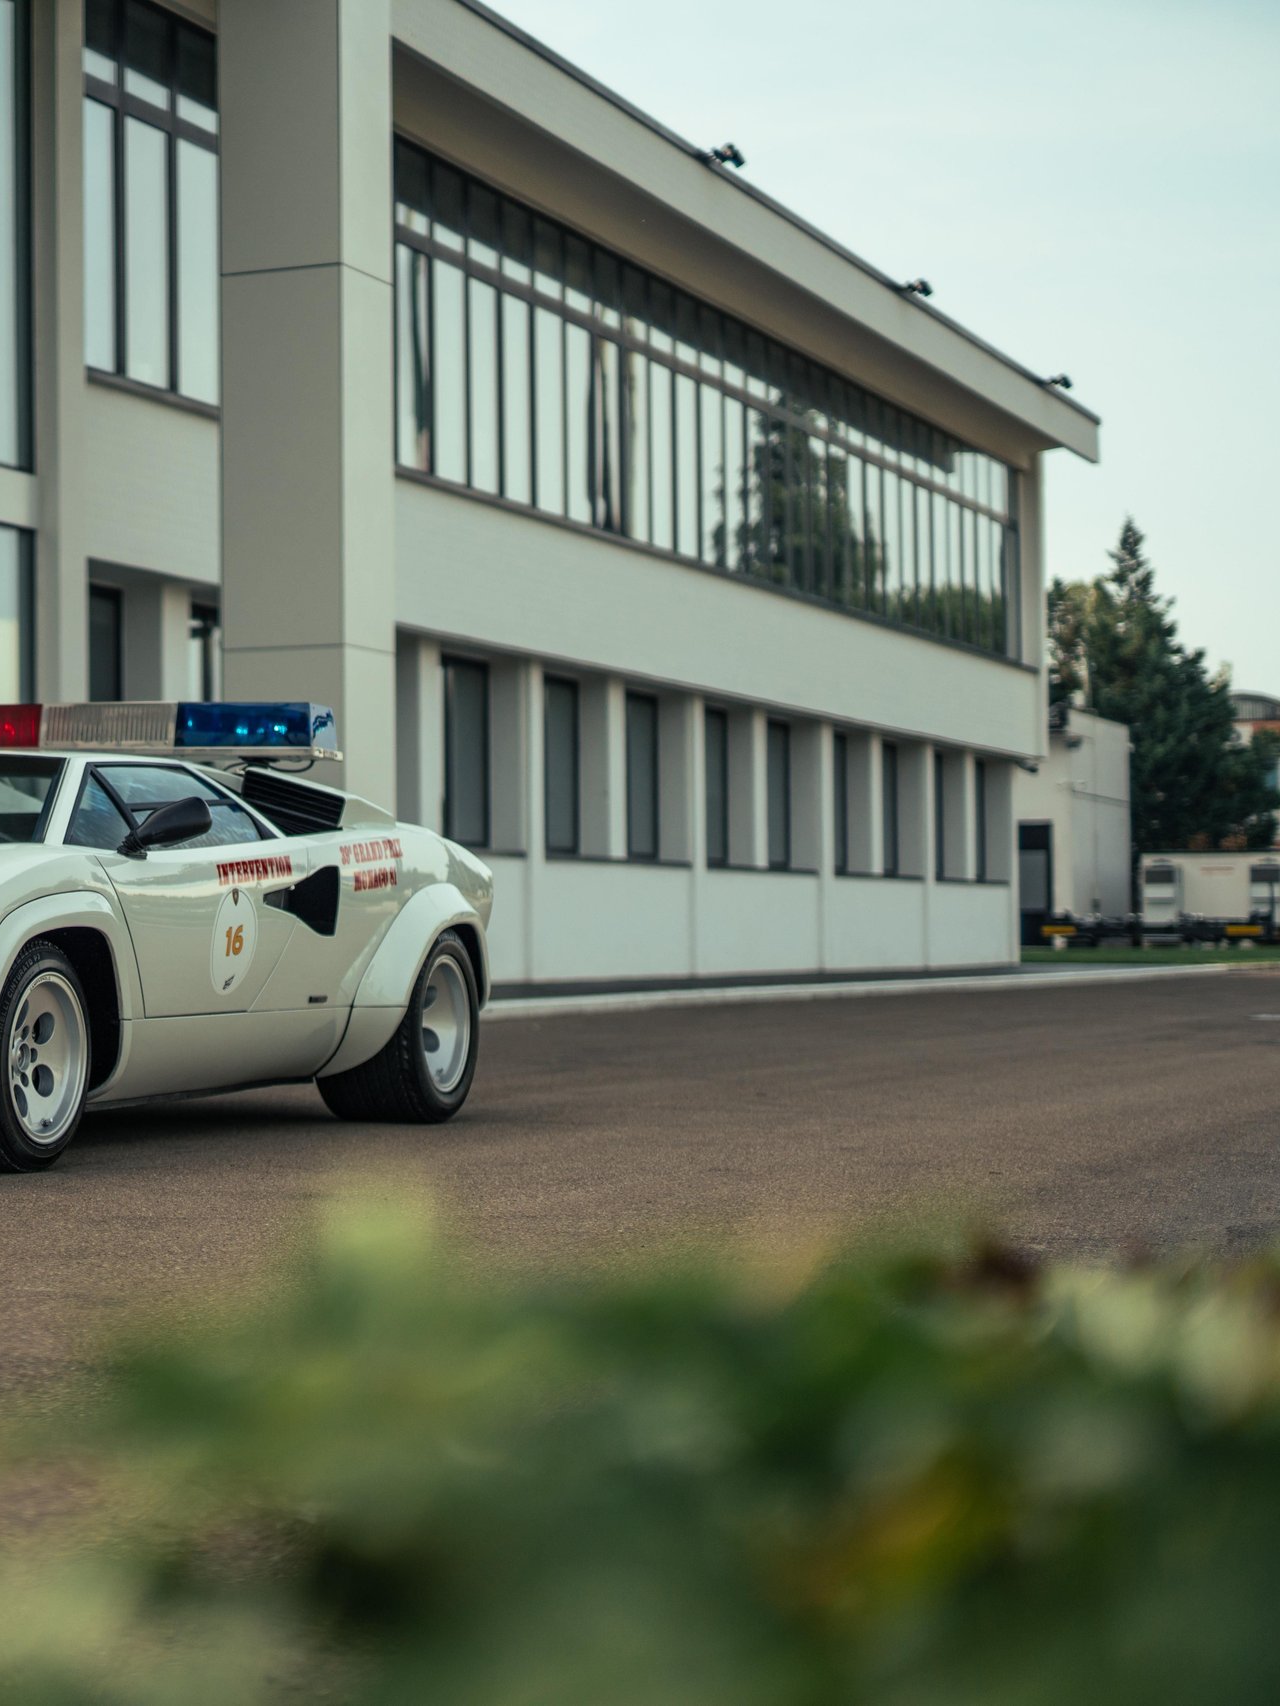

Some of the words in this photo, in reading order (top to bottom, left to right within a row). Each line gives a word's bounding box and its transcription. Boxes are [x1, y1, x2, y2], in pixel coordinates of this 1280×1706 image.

[352, 842, 383, 864] GRAND
[381, 838, 403, 859] PRIX
[216, 855, 293, 886] INTERVENTION
[353, 868, 389, 892] MONACO
[225, 924, 243, 957] 16
[7, 958, 33, 998] CINTURATO
